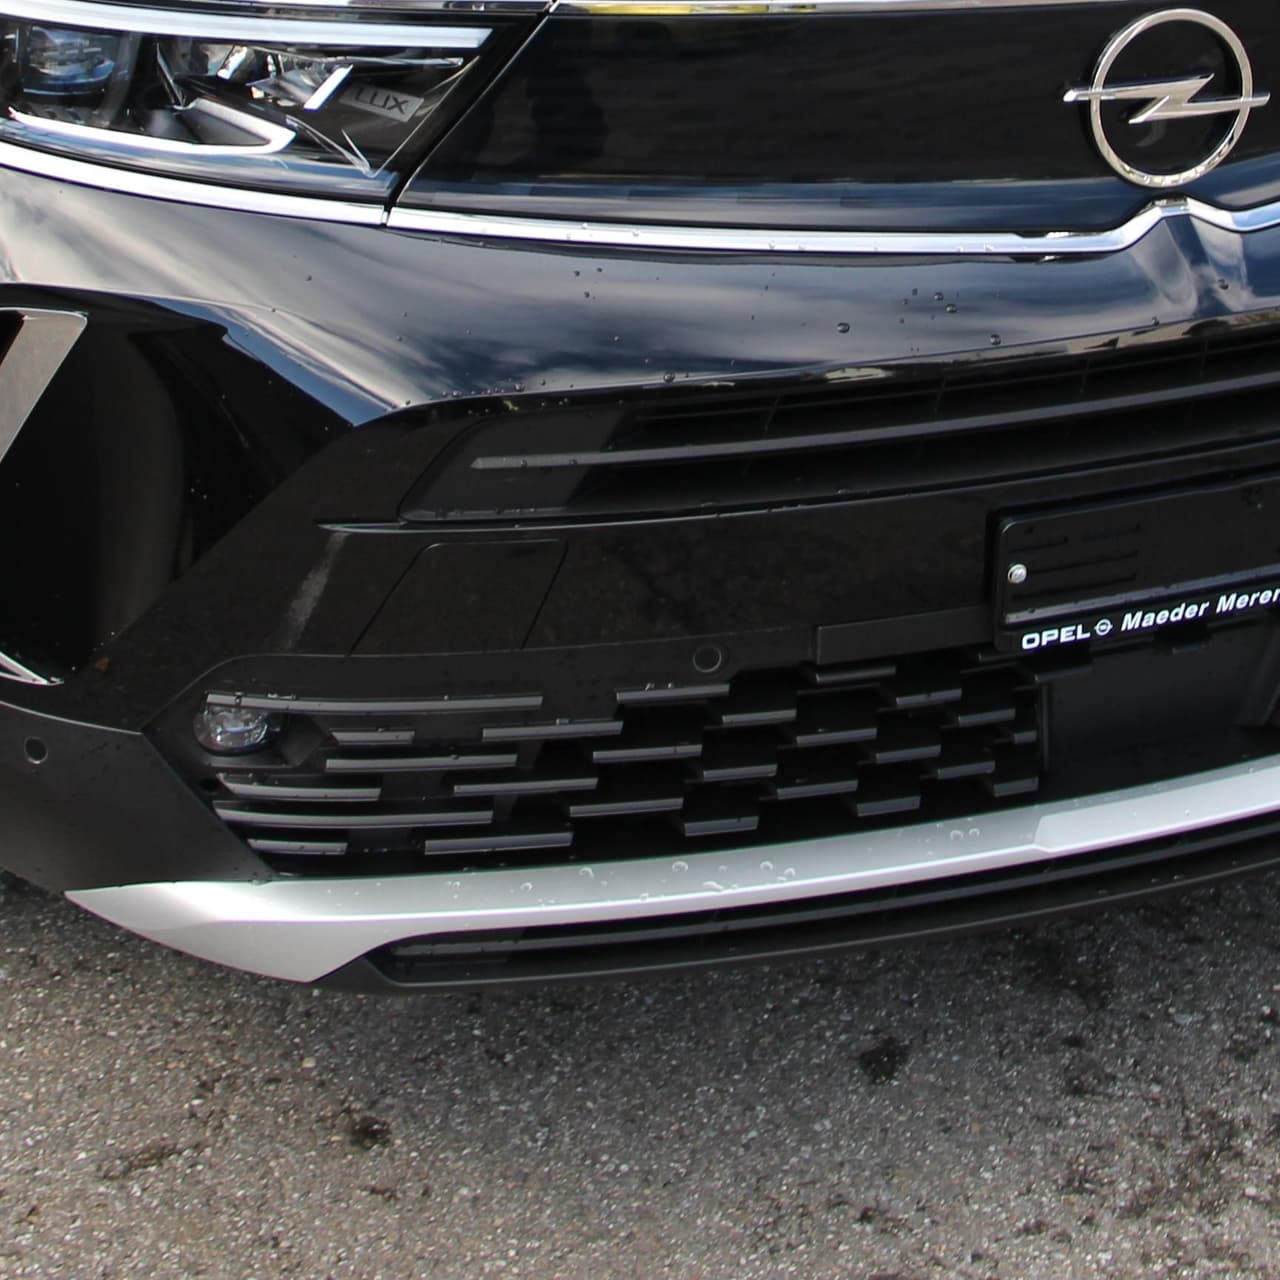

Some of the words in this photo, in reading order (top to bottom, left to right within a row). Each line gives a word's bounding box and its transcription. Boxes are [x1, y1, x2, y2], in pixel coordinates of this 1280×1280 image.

[355, 87, 409, 115] LUX
[1022, 624, 1091, 650] OPEL
[1121, 601, 1210, 632] Maeder
